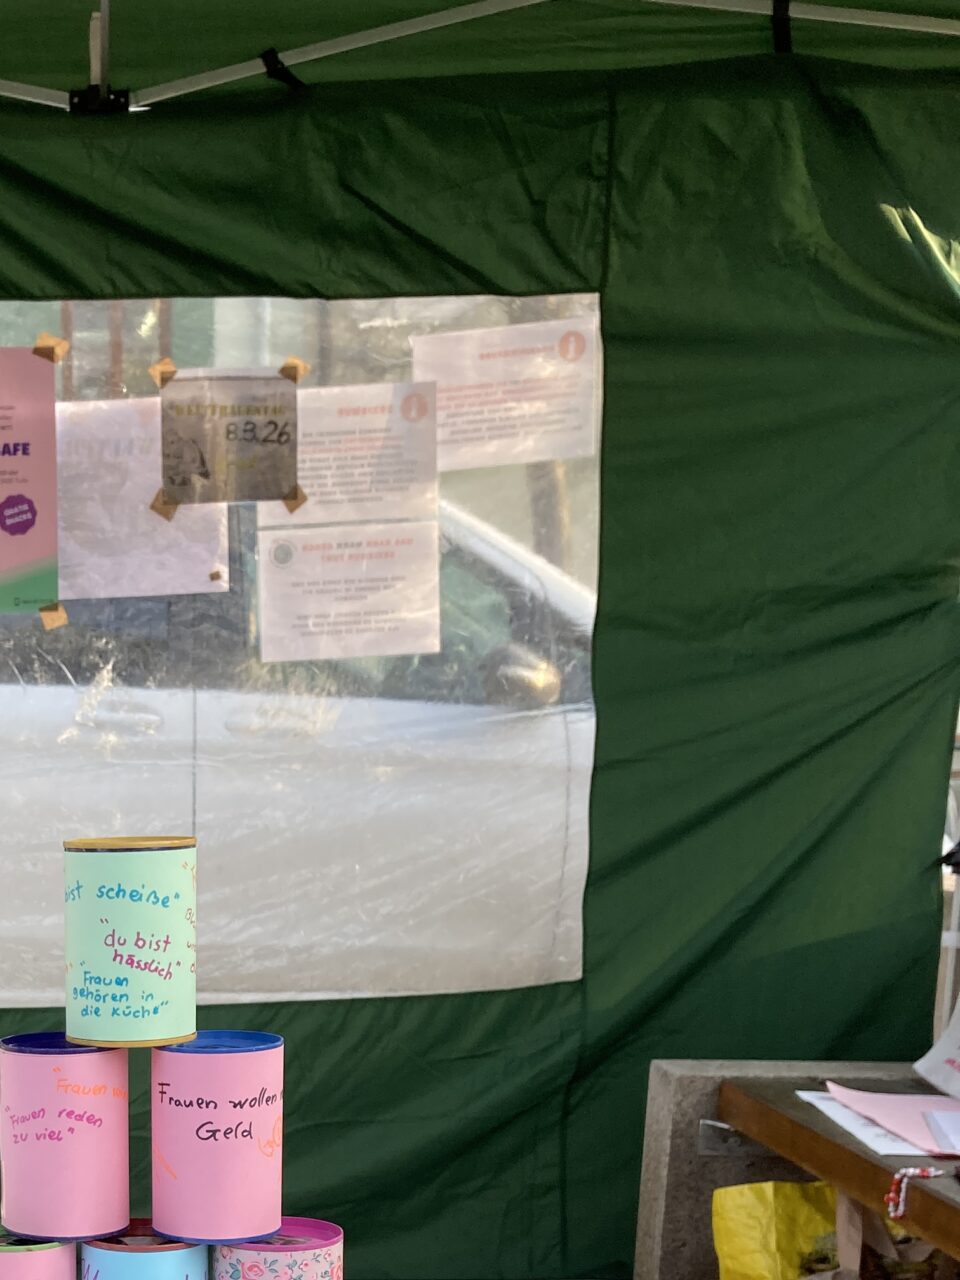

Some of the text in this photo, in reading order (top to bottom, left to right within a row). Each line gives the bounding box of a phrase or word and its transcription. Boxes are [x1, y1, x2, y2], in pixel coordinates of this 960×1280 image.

[134, 931, 171, 953] bist
[72, 986, 154, 1004] gehören in
[81, 1004, 101, 1017] die
[158, 1082, 218, 1109] Frauen
[229, 1087, 277, 1109] wollen
[57, 1108, 103, 1128] reden
[13, 1133, 28, 1144] zu
[196, 1121, 253, 1141] Geld
